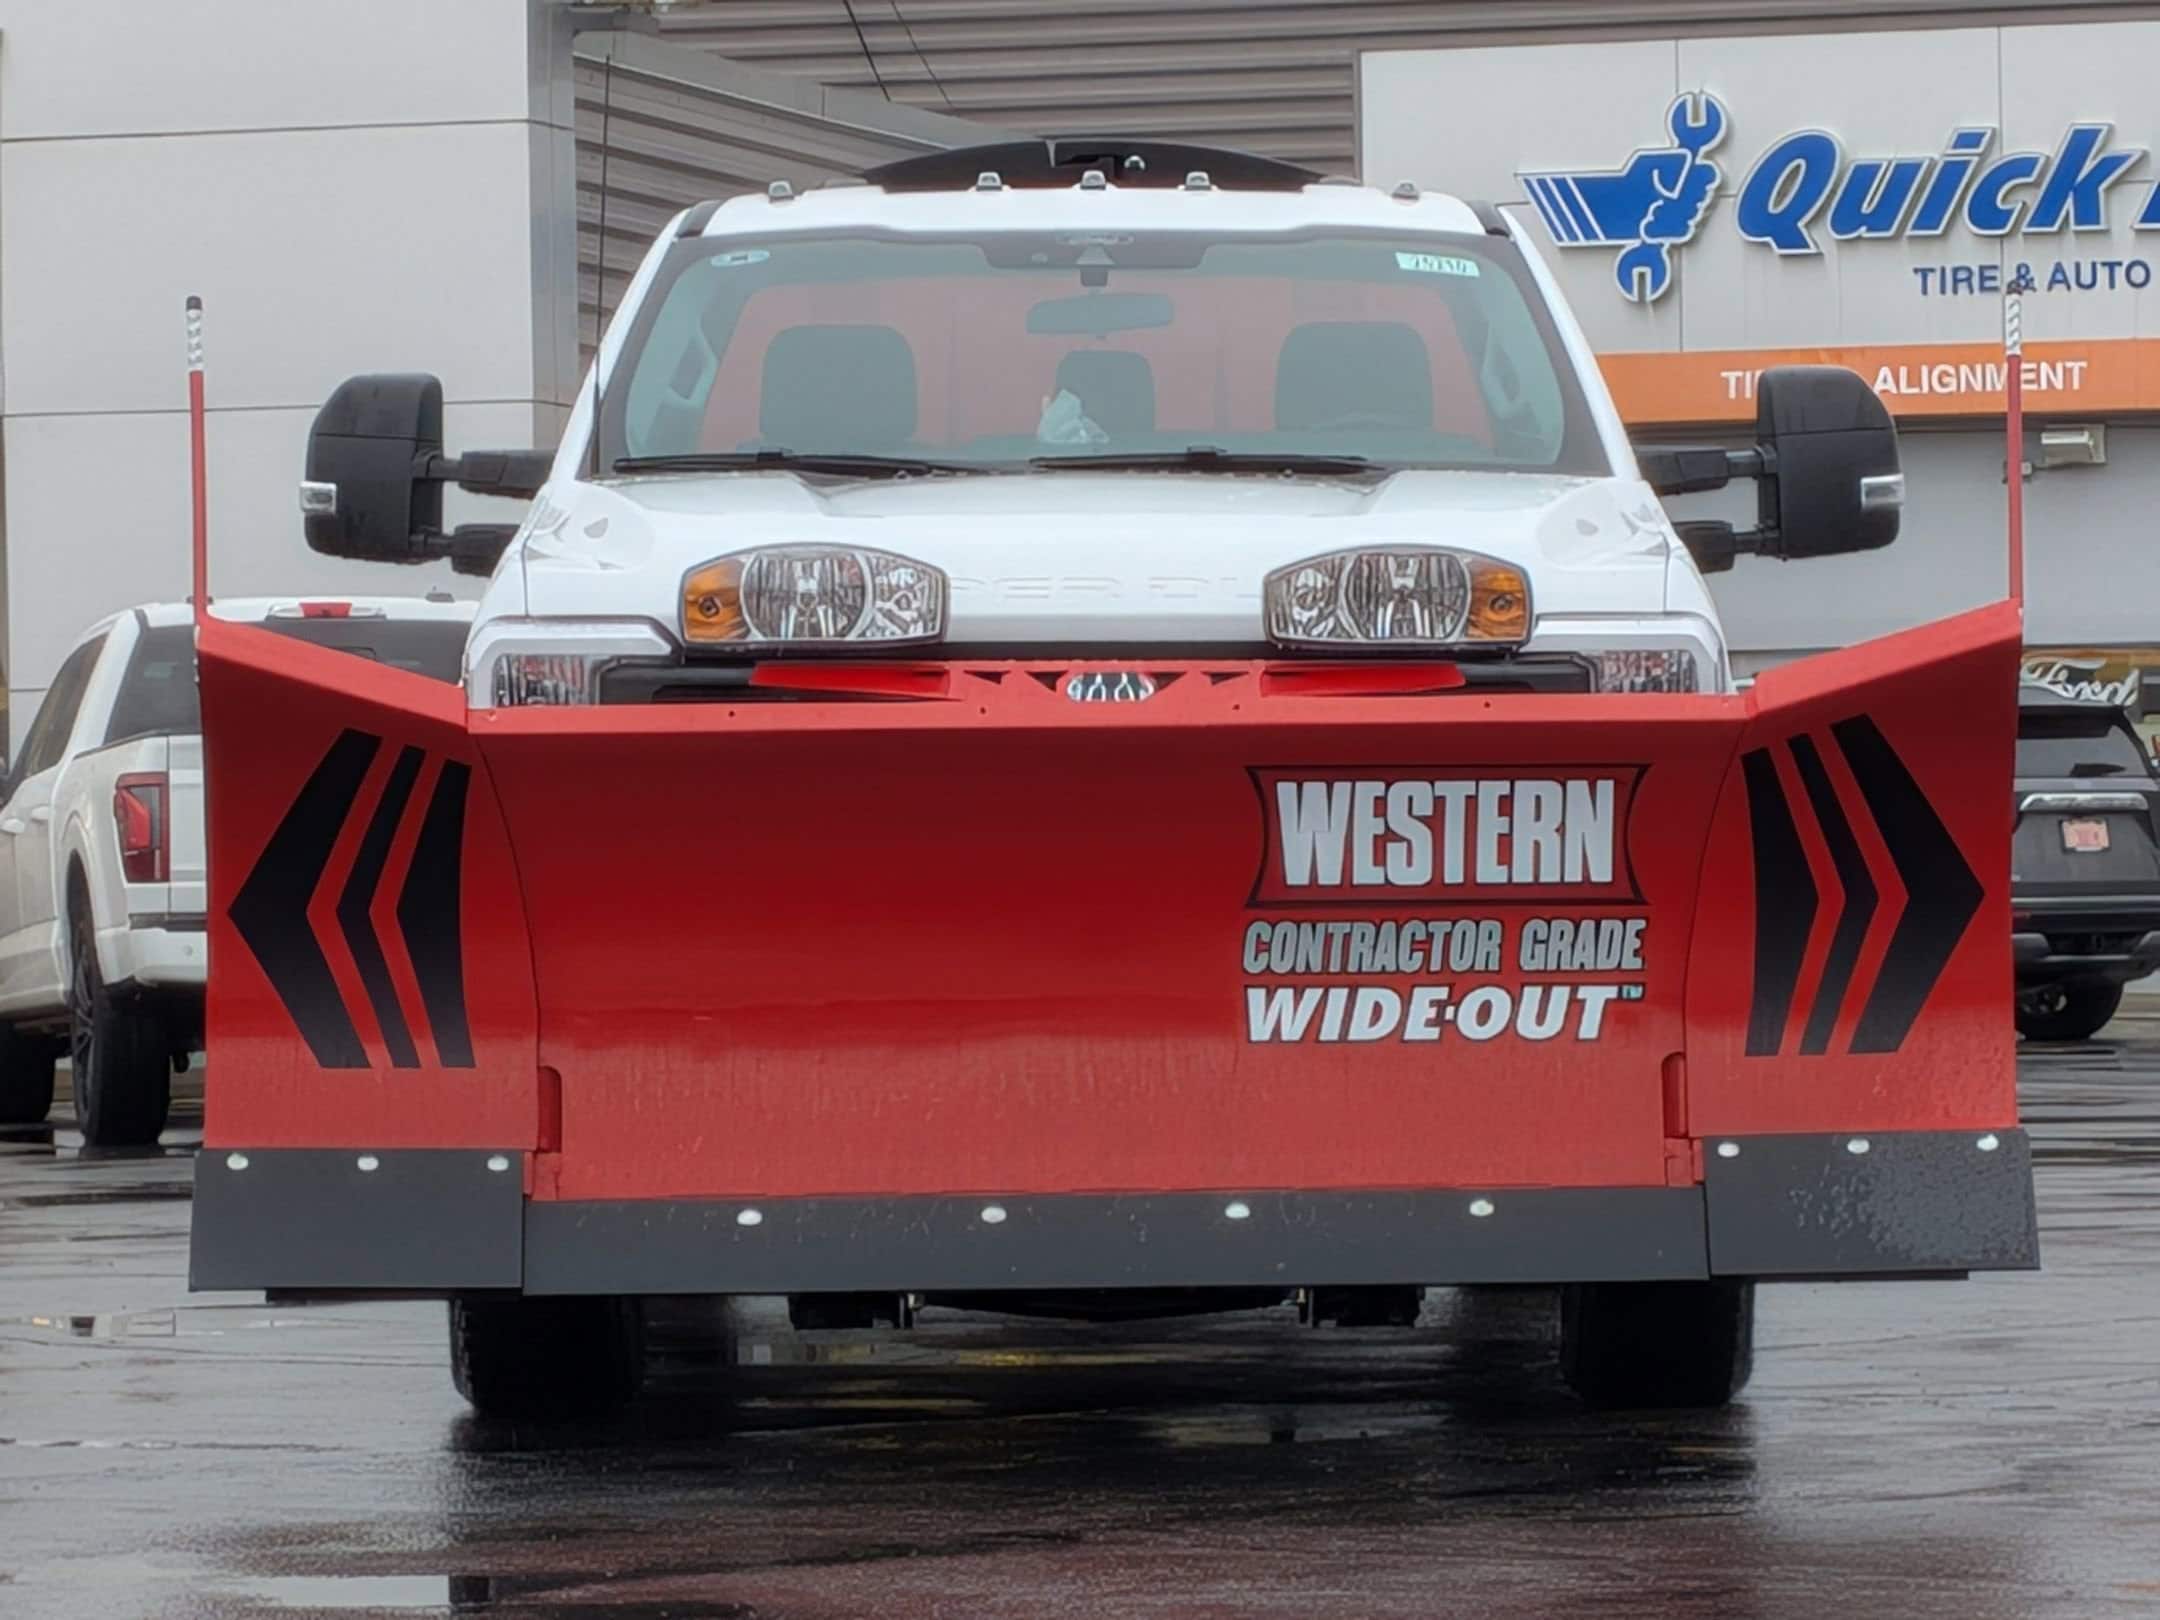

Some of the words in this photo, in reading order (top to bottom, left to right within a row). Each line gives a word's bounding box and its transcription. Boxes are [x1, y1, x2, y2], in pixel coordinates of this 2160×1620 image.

[1739, 124, 2144, 255] Quick
[1913, 264, 2000, 295] TIRE
[2012, 262, 2036, 292] &
[2046, 260, 2151, 292] AUTO
[1276, 780, 1615, 886] WESTERN
[1243, 920, 1501, 974] CONTRACTOR
[1519, 919, 1647, 971] GRADE
